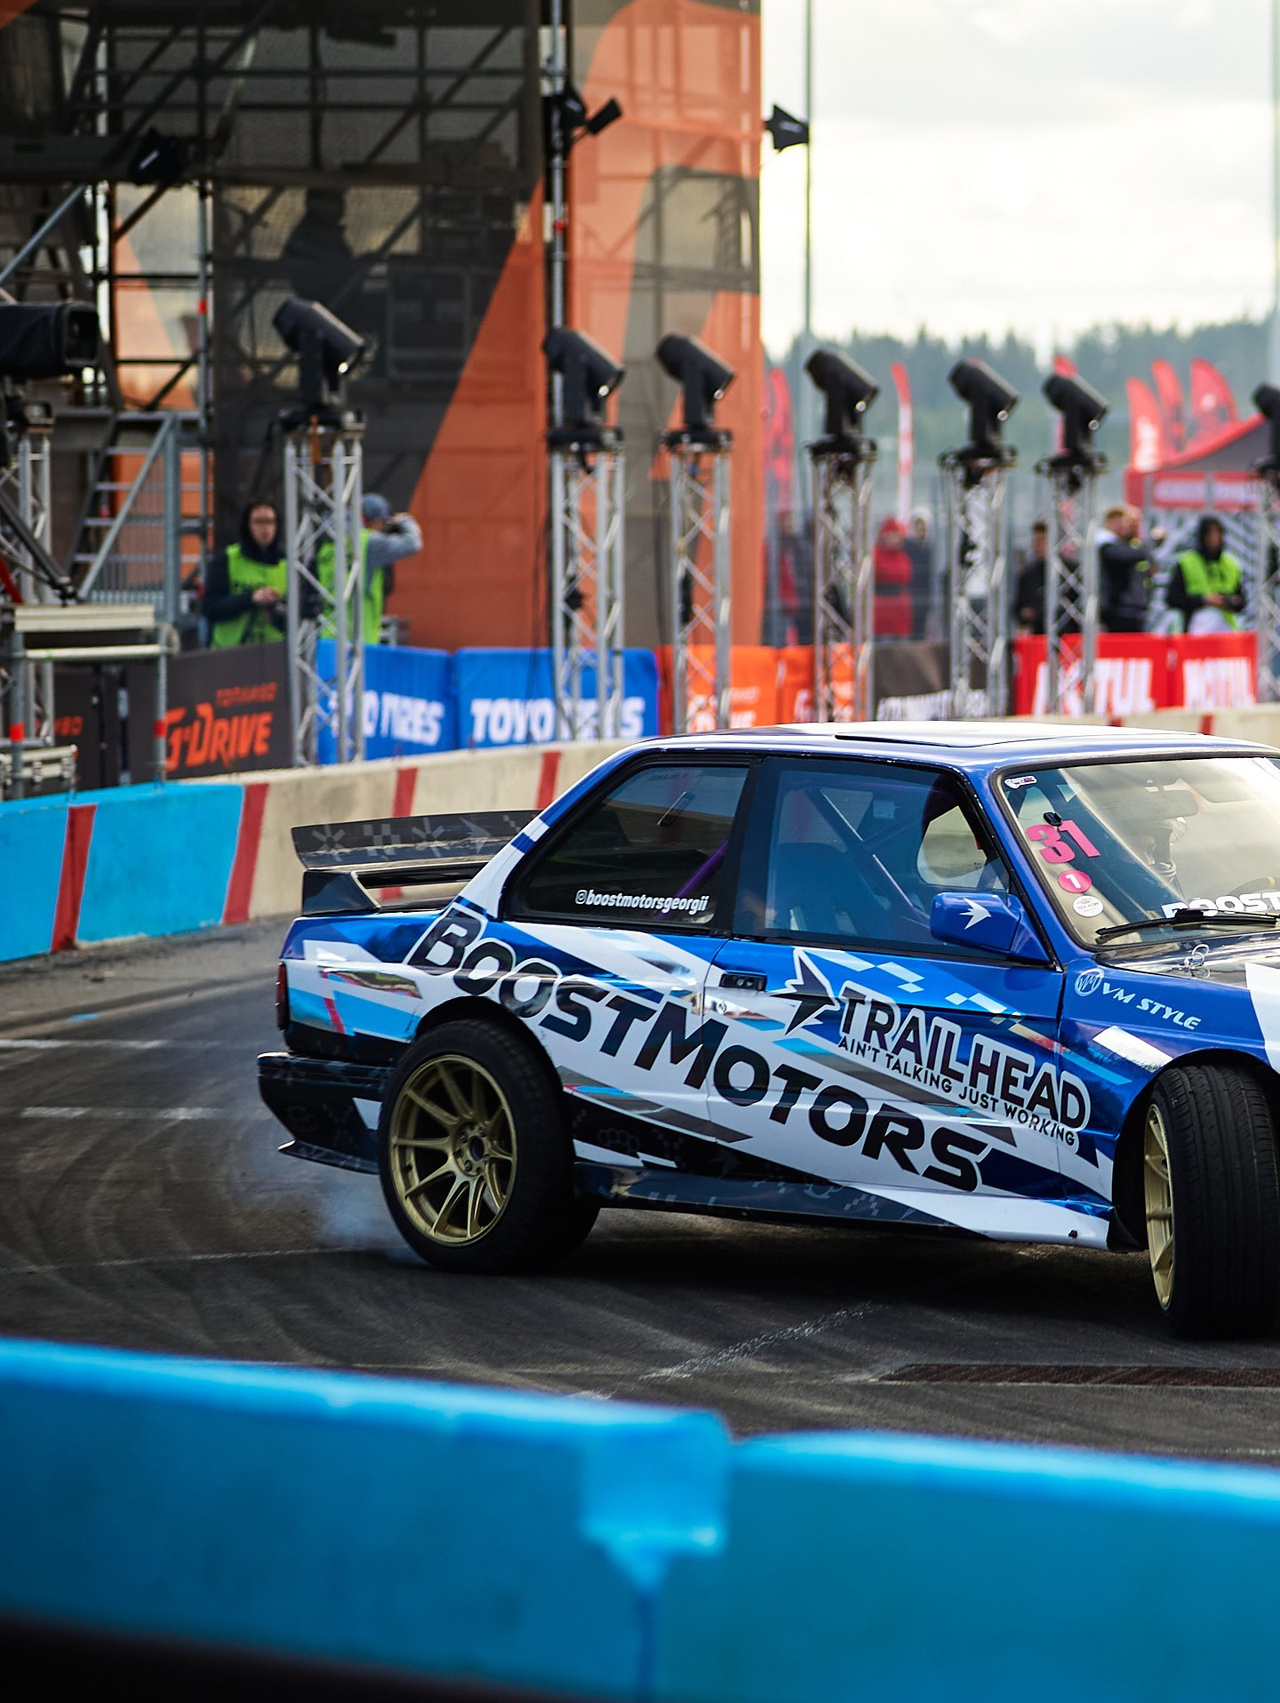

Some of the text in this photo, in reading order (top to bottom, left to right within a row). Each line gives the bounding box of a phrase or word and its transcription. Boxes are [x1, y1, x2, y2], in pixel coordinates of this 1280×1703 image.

[470, 697, 557, 743] TOYO
[1026, 820, 1101, 864] 31
[575, 889, 709, 916] @boostmotorsgeorgii
[1065, 873, 1081, 889] 1
[1102, 982, 1201, 1030] VM STYLE
[407, 905, 988, 1192] BOOSTMOTORS
[841, 986, 1087, 1130] TRAILHEAD
[838, 1035, 1075, 1147] AIN'T TALKING JUST WORKING
